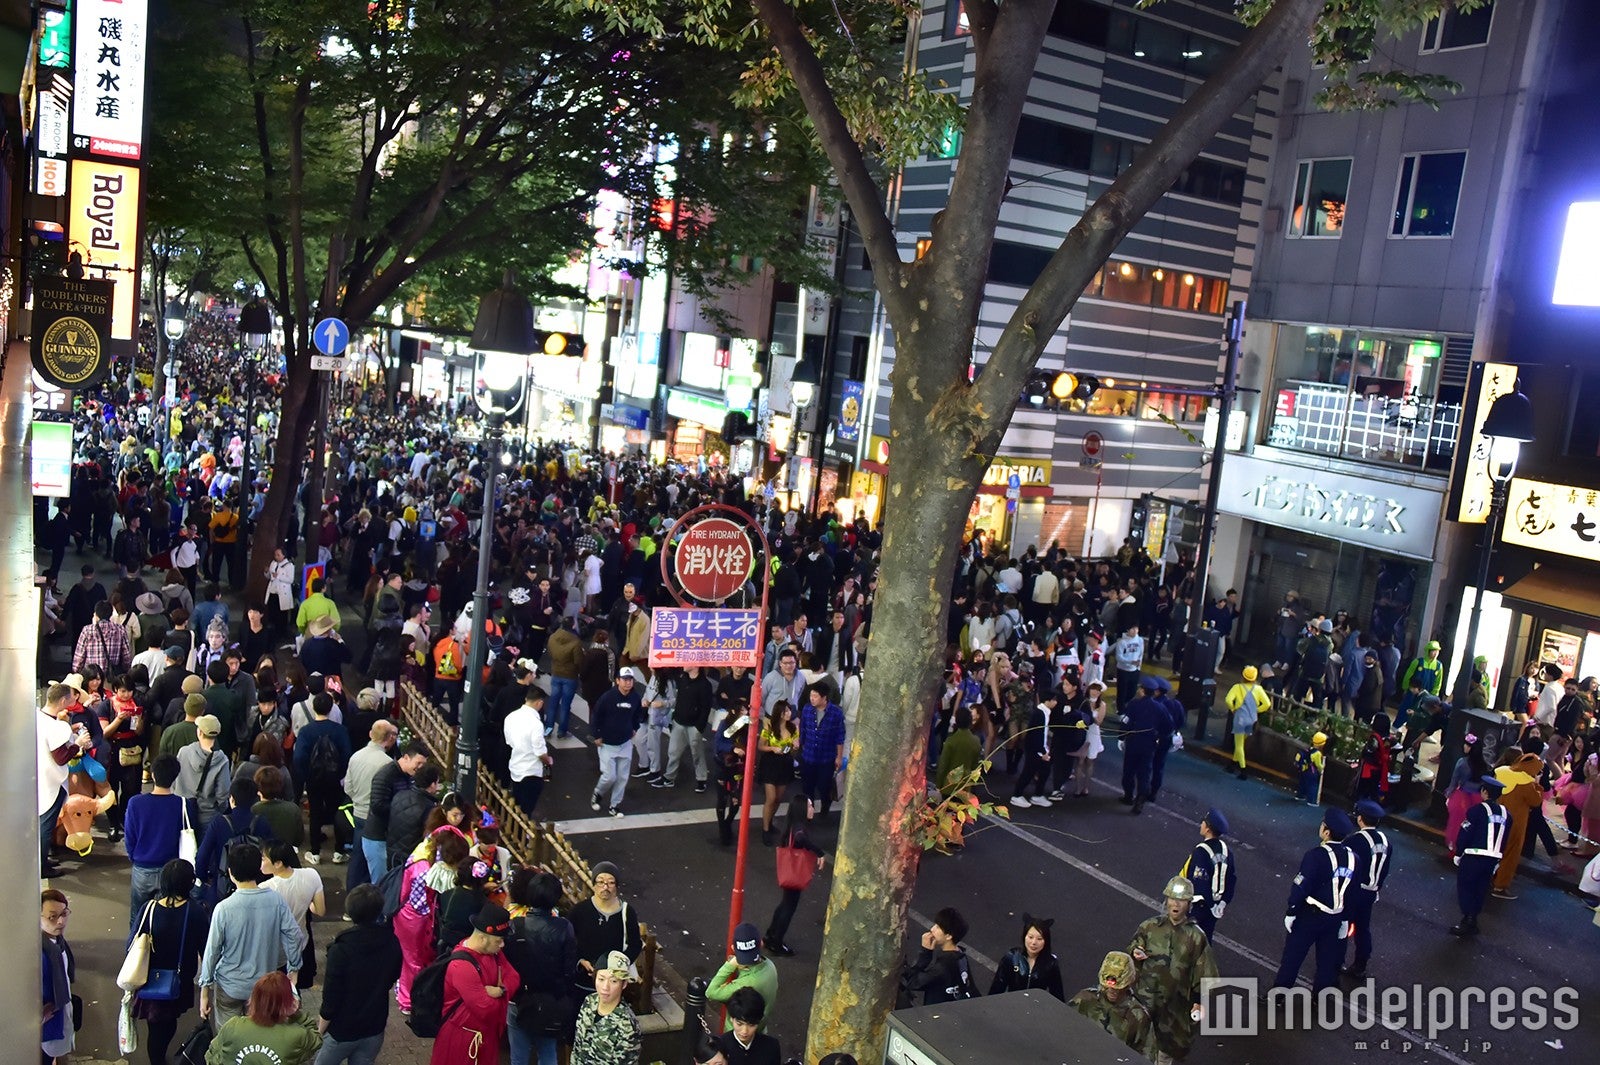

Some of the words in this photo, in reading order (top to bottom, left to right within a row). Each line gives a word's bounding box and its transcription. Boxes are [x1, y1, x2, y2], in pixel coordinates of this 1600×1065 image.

[96, 17, 122, 120] 磯丸水産
[74, 136, 89, 148] 6F
[86, 174, 122, 251] Royal
[64, 281, 87, 291] THE
[82, 304, 105, 314] PUB
[47, 320, 68, 343] GUINNESS
[68, 320, 87, 332] EXTRA
[46, 343, 97, 357] GUINNESS
[33, 391, 66, 410] 2F
[691, 530, 707, 539] FIRE
[708, 530, 741, 539] HYDRANT
[683, 544, 747, 575] 消火栓
[671, 638, 747, 649] 03-3464-2061
[731, 651, 751, 662] 買取
[736, 939, 756, 951] POLICE
